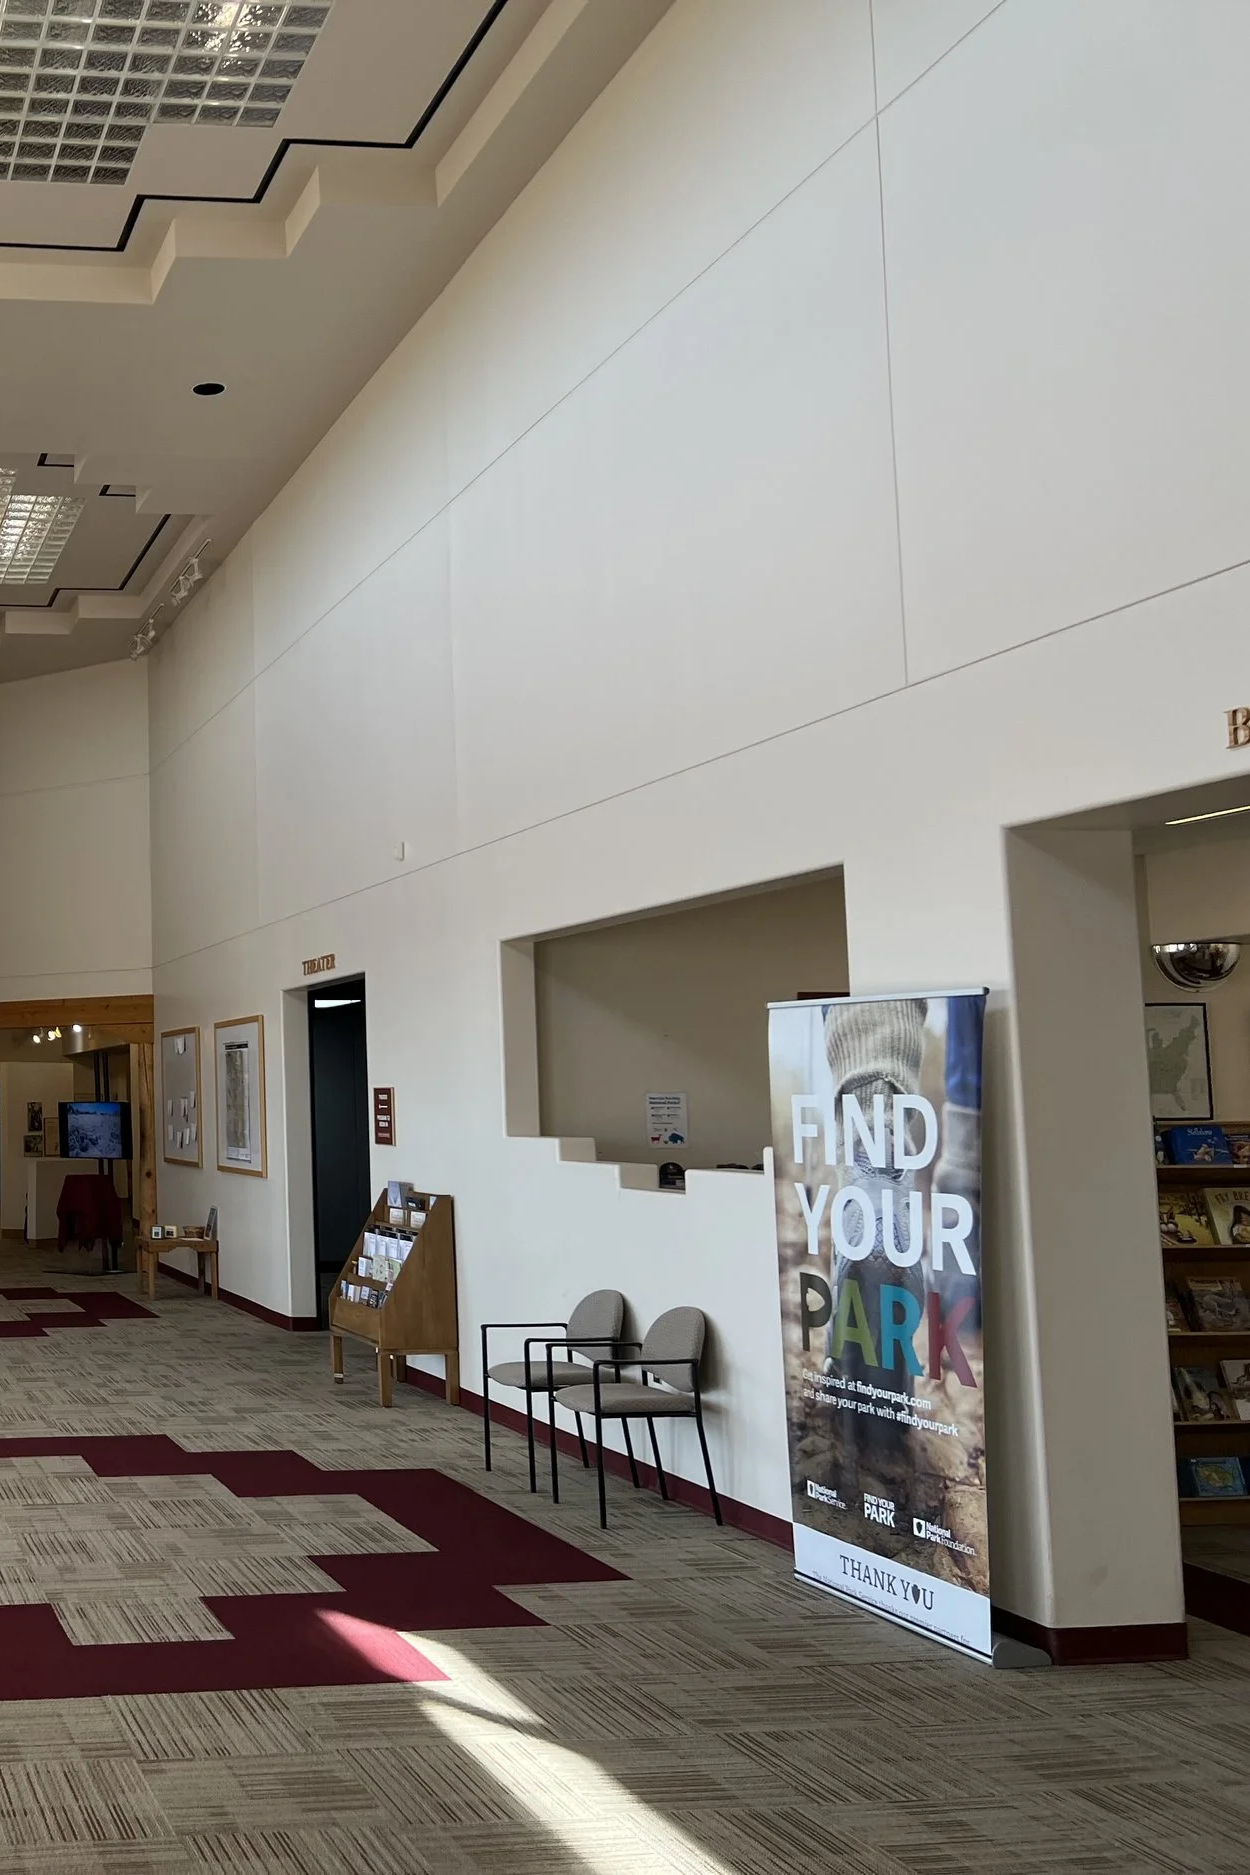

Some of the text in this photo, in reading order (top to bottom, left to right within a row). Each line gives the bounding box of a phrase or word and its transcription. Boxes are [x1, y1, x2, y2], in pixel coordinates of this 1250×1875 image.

[302, 953, 336, 976] THEATER
[791, 1093, 938, 1170] FIND
[794, 1182, 977, 1276] YOUR
[799, 1272, 977, 1388] PARK
[802, 1368, 932, 1410] Get inspired at findyourpark.com
[803, 1387, 959, 1437] and share your park with #findyourpark
[864, 1502, 896, 1528] PARK
[878, 1497, 895, 1511] YOUR
[926, 1521, 951, 1538] National
[840, 1554, 898, 1596] THANK
